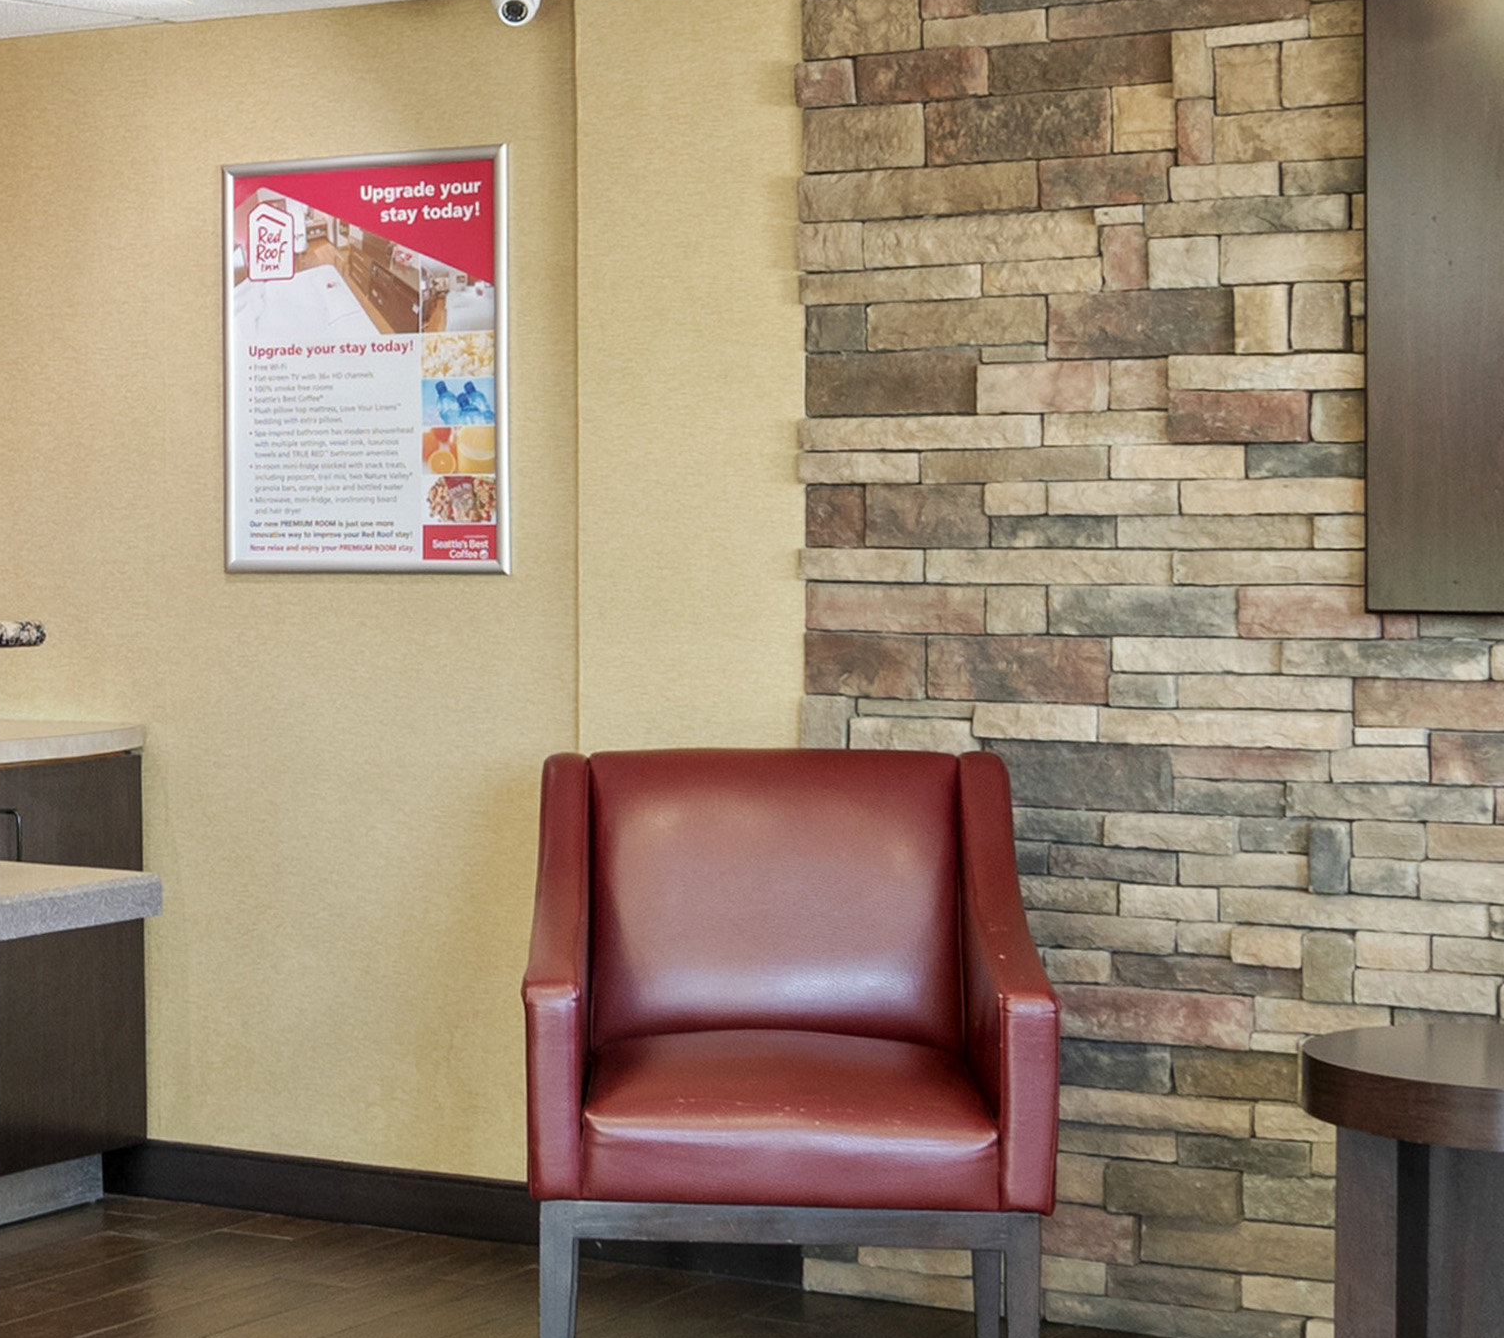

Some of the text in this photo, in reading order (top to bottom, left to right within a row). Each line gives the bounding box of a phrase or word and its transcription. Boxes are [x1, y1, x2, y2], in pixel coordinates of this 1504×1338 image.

[360, 181, 481, 202] Upgrade your
[380, 202, 481, 224] stay today!
[258, 227, 281, 244] Red
[256, 242, 287, 263] Roof
[249, 340, 414, 359] Upgrade your stay today!
[449, 549, 478, 558] Coffee
